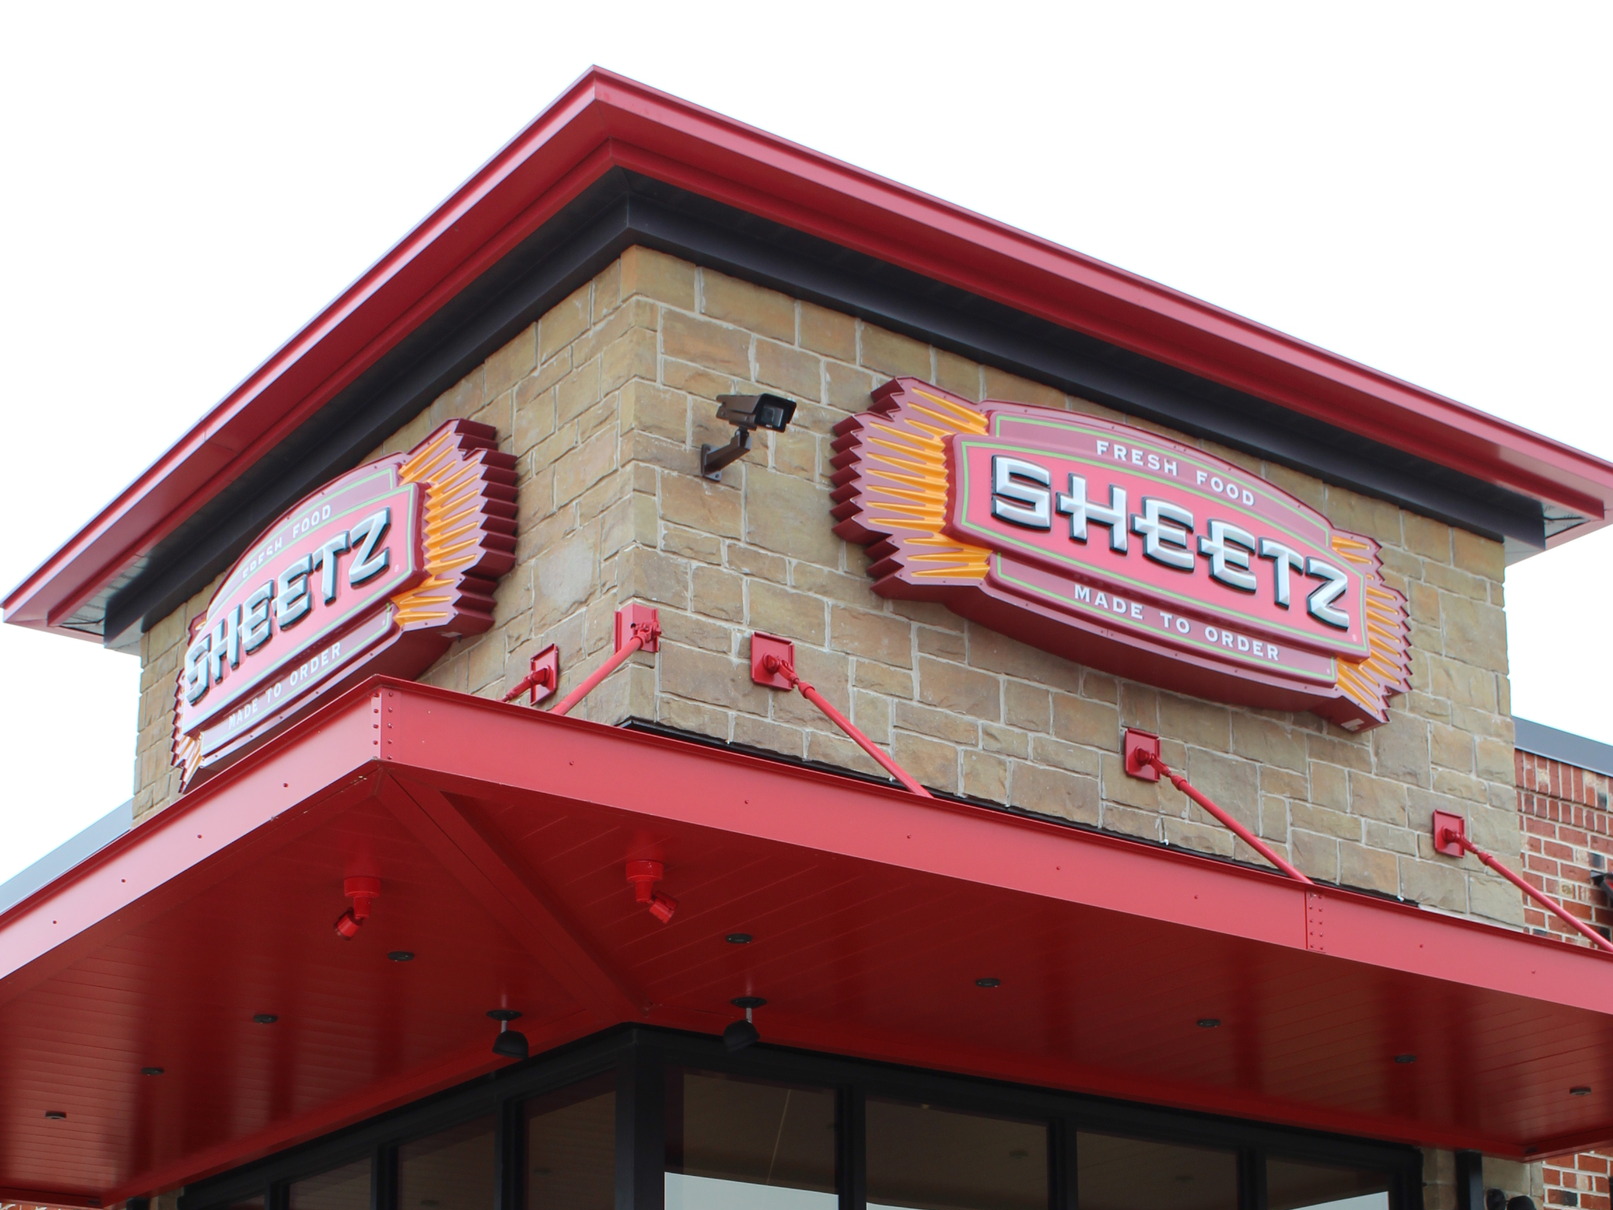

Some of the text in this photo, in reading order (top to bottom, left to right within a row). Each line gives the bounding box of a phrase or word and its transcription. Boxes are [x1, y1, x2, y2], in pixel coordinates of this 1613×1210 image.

[1096, 440, 1255, 506] FRESH FOOD
[292, 504, 331, 538] FOOD
[990, 454, 1350, 630] SHEETZ
[184, 506, 391, 706] SHEETZ
[1074, 584, 1279, 660] MADE TO ORDER
[229, 642, 341, 730] MADE TO ORDER
